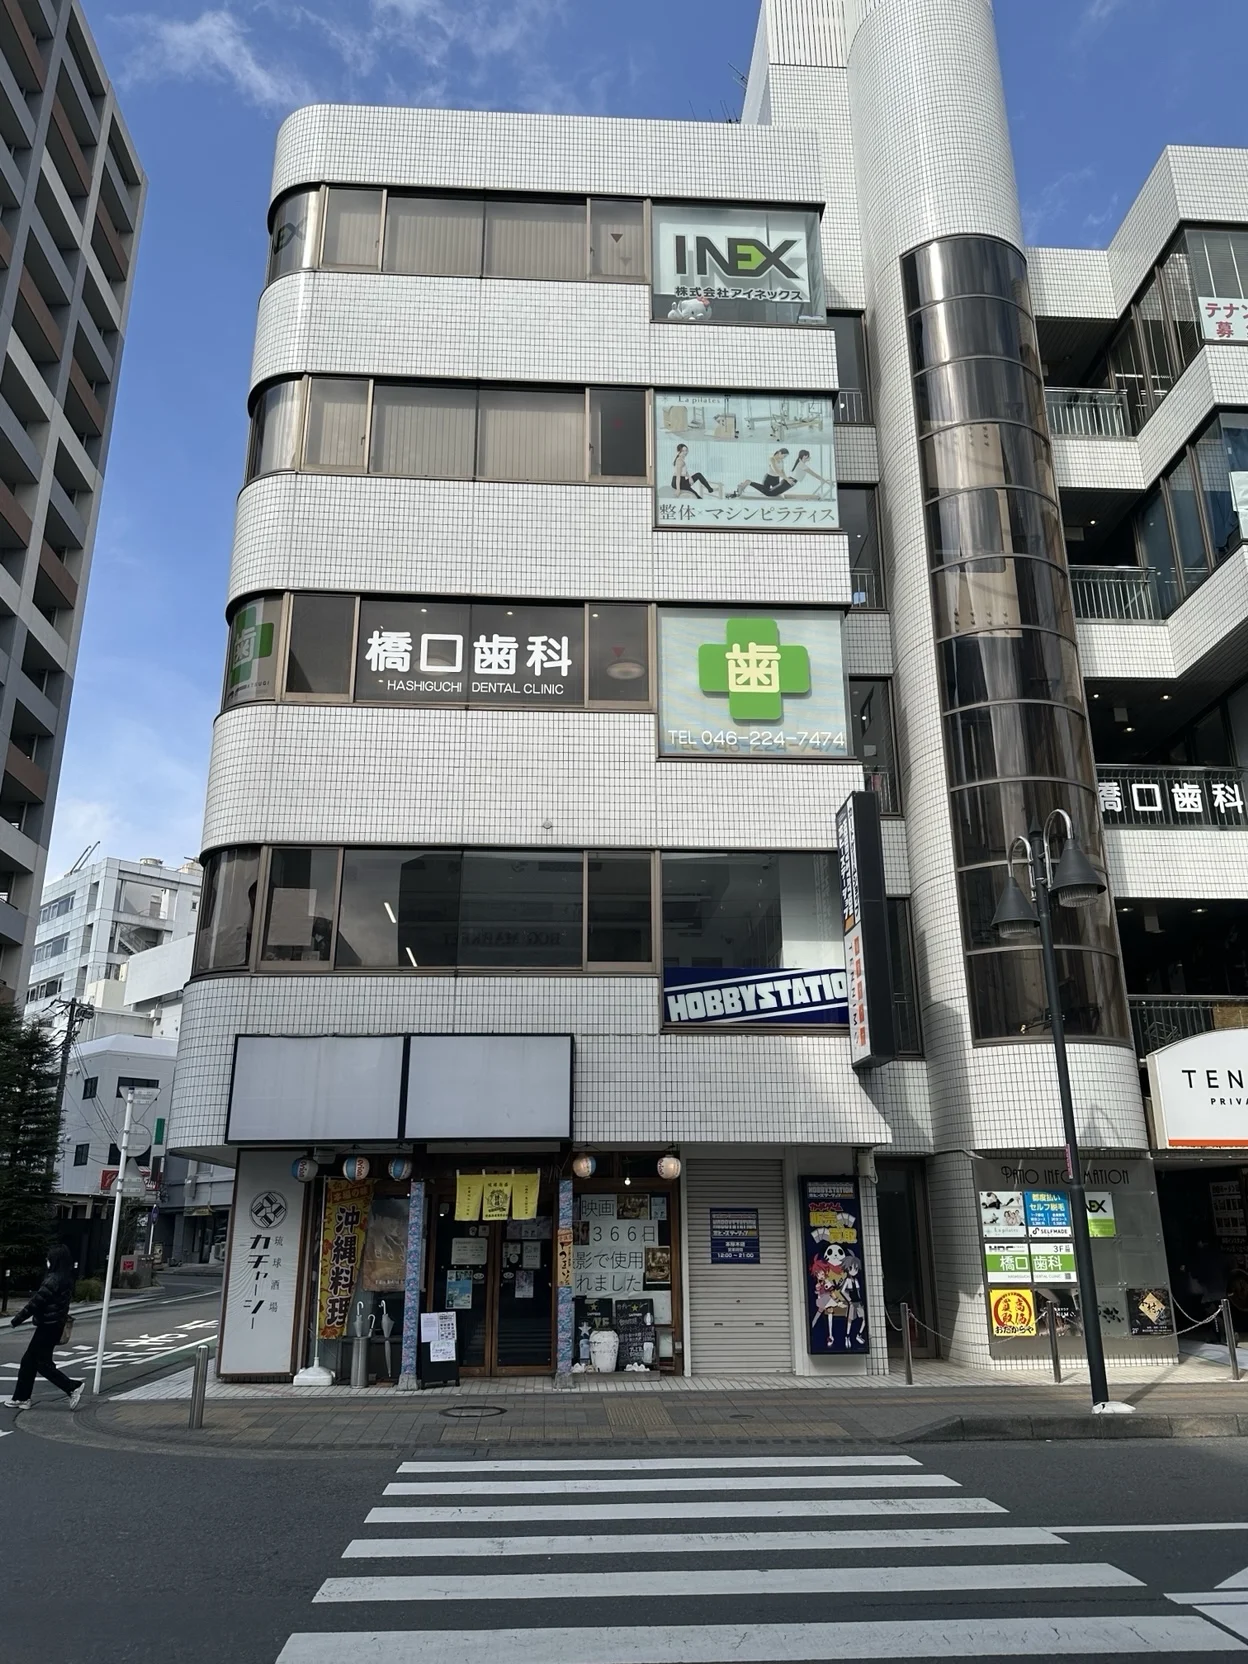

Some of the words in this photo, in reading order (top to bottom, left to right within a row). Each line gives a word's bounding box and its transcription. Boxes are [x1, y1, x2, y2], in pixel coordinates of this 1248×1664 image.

[675, 235, 801, 279] INEX
[675, 285, 803, 301] 株式会社アイネックス
[365, 630, 573, 677] 橋口歯科
[725, 641, 782, 693] 歯
[387, 680, 463, 693] HASHIGUCHI
[471, 682, 521, 694] DENTAL
[523, 684, 564, 695] CLINIC
[668, 730, 697, 744] TEL
[701, 731, 845, 746] 046-224-7474
[1044, 1168, 1130, 1185] INFOMATION
[581, 1199, 615, 1218] 映画
[326, 1204, 361, 1327] 沖縄料理
[573, 1251, 644, 1269] 影で使用
[1000, 1256, 1063, 1271] 橋口歯科
[243, 1234, 271, 1329] カチャーシー
[269, 1235, 284, 1313] 琉球酒場
